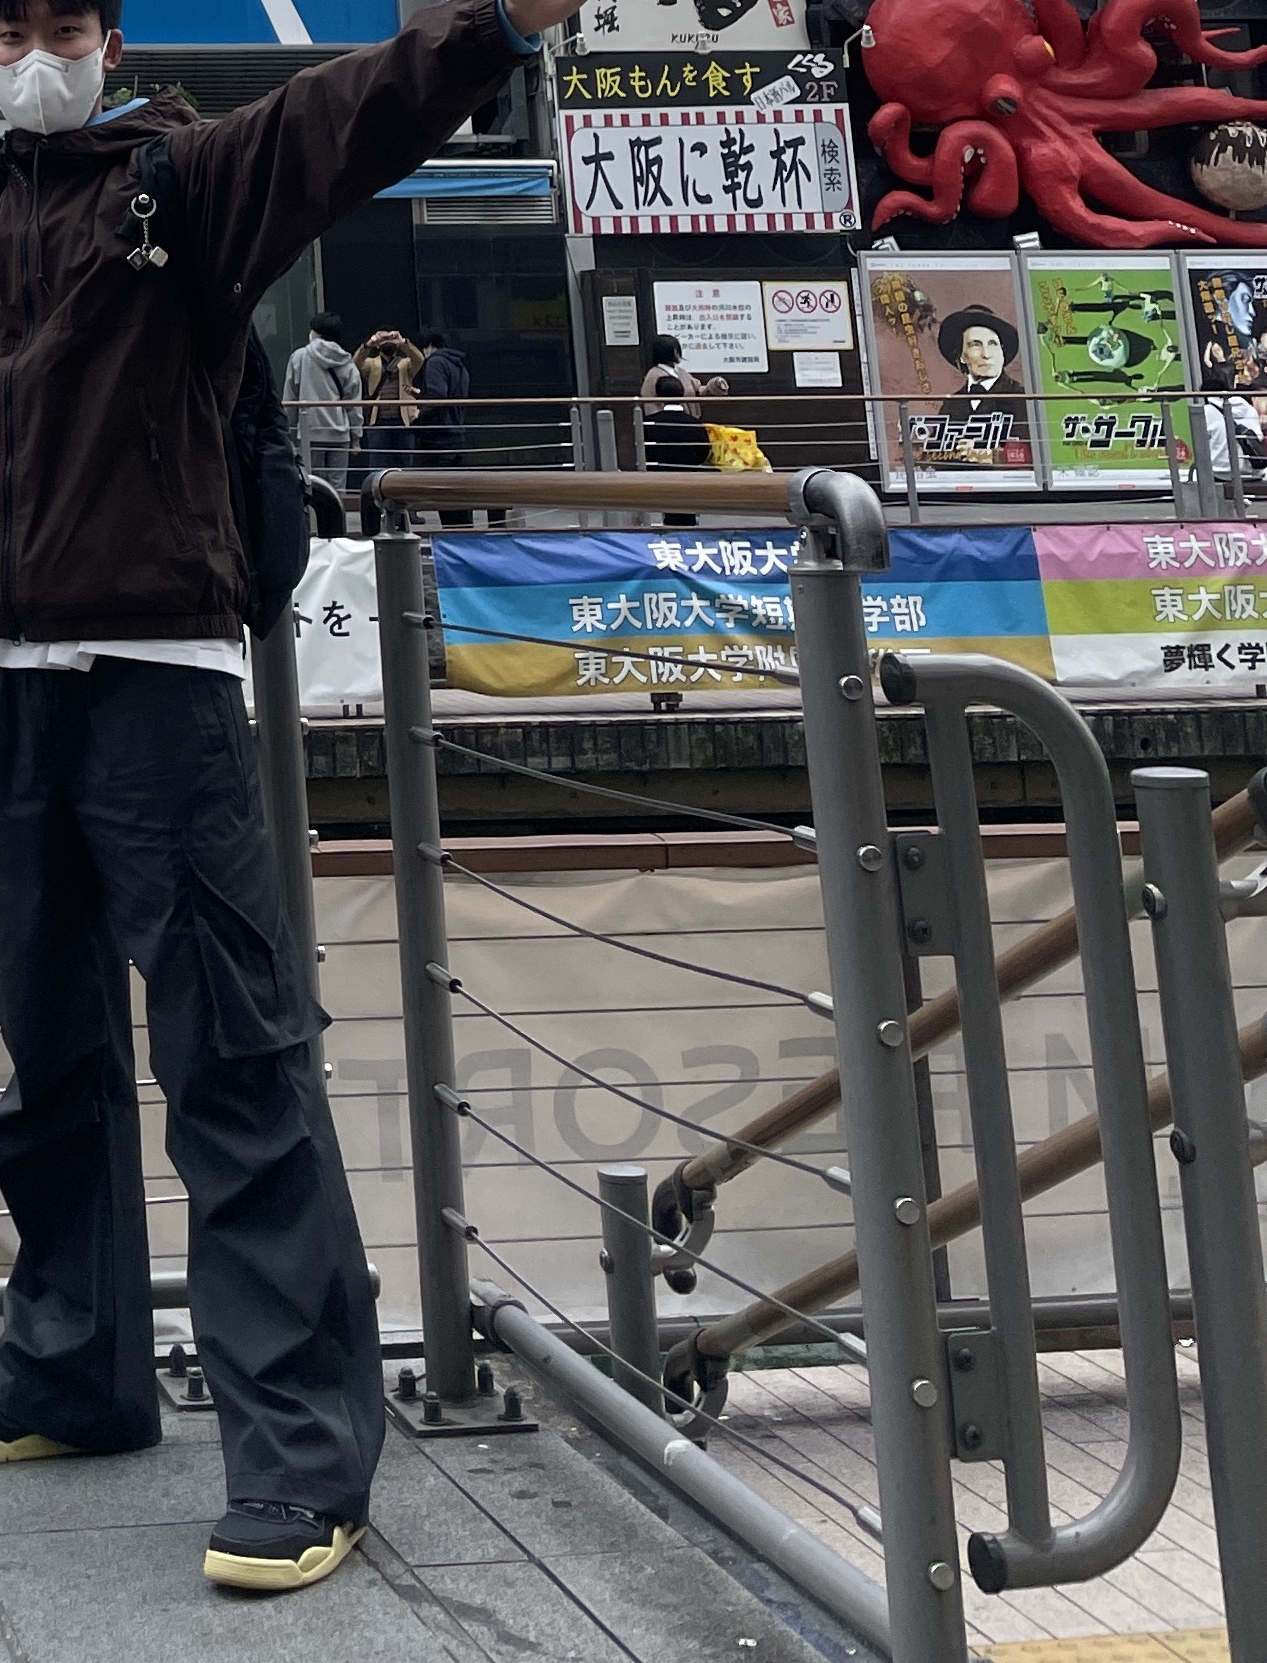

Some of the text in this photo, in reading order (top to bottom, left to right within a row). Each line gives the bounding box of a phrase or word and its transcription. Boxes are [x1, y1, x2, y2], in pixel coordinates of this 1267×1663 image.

[563, 61, 761, 100] 大阪もんを食す
[787, 53, 835, 79] くくる
[805, 80, 839, 102] 2F
[581, 126, 812, 212] 大阪に乾杯
[820, 138, 843, 194] 検索
[648, 540, 801, 575] 東大阪大
[569, 591, 927, 633] 東大阪大学短学部
[1151, 584, 1267, 623] 東大阪
[1161, 642, 1267, 674] 夢輝く学
